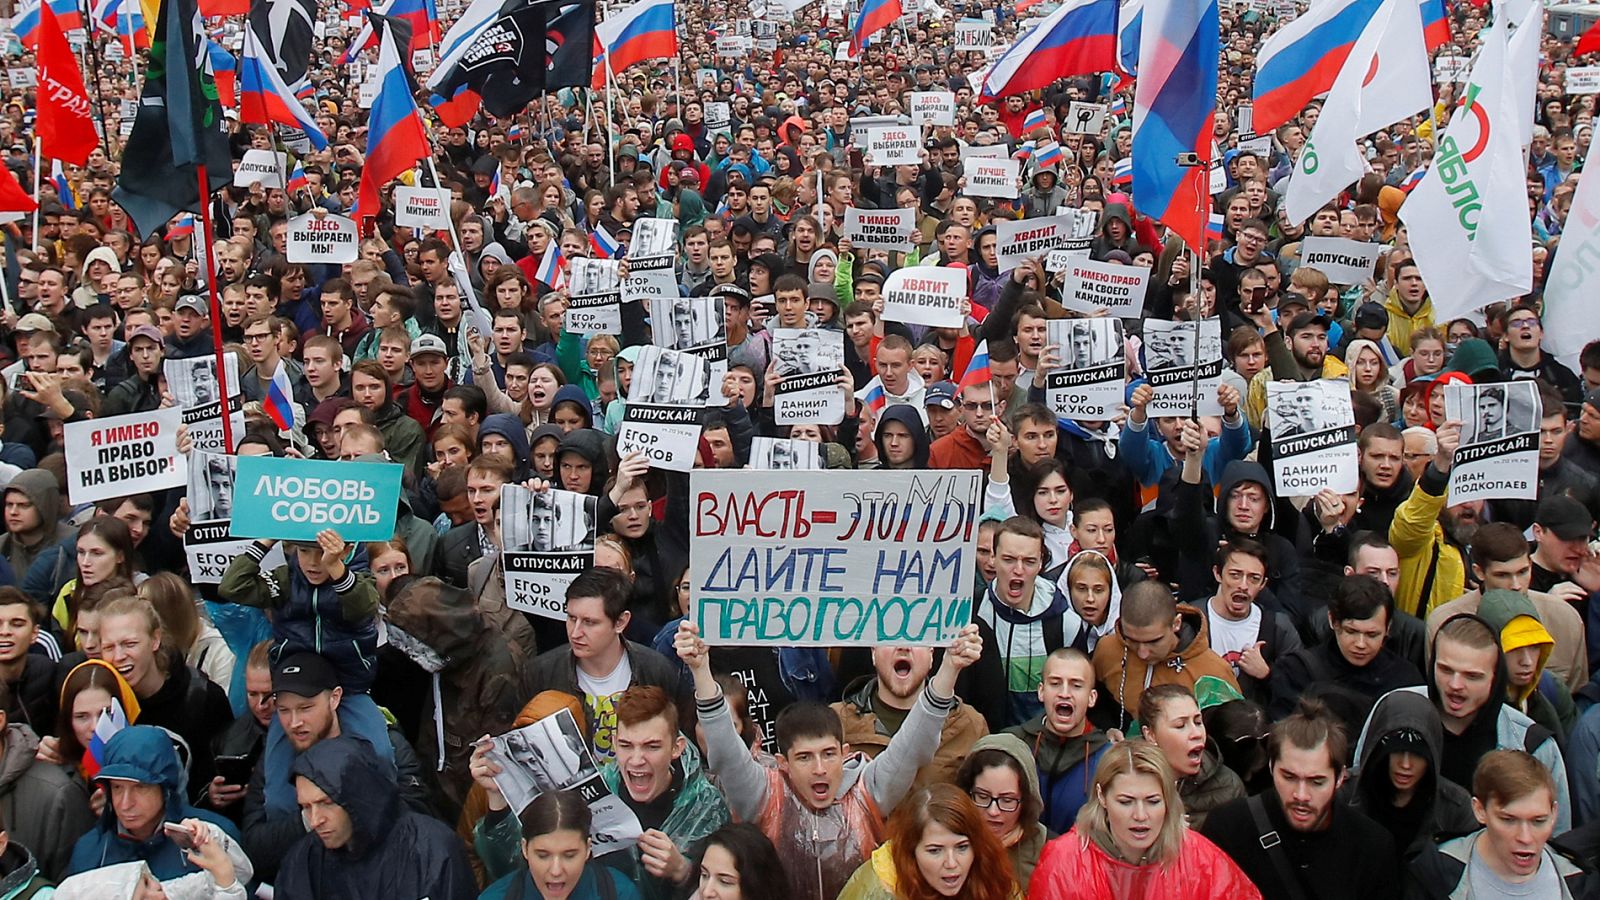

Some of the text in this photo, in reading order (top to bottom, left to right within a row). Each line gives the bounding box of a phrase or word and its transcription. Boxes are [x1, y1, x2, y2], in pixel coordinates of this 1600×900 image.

[920, 96, 941, 104] ЗДЕСЬ
[914, 104, 949, 112] ВЫБИРАЕМ
[882, 131, 907, 139] ЗДЕСЬ
[873, 141, 917, 150] ВЫБИРАЕМ
[886, 150, 904, 158] МЫ!
[977, 167, 1006, 176] ЛУЧШЕ
[972, 177, 1009, 186] МИТИНГ!
[409, 196, 438, 207] ЛУЧШЕ
[405, 205, 441, 217] МИТИНГ!
[306, 220, 340, 231] ЗДЕСЬ
[858, 215, 900, 226] Я ИМЕЮ
[861, 225, 897, 235] ПРАВО
[1014, 225, 1057, 242] ХВАТИТ
[293, 231, 352, 243] ВЫБИРАЕМ
[851, 233, 908, 245] НА ВЫБОР!
[311, 243, 334, 254] МЫ!
[1001, 234, 1067, 255] НАМ ВРАТЬ!
[628, 259, 669, 269] ТПУСКАЙ!
[1306, 252, 1370, 268] ДОПУСКАЙ!
[624, 277, 649, 288] ЕГОР
[1073, 268, 1141, 286] Я ИМЕЮ ПРАВО
[625, 286, 662, 296] ЖУКОВ
[902, 278, 949, 292] ХВАТИТ
[1081, 281, 1129, 296] НА СВОЕГО
[571, 295, 618, 307] ОТПУСКАЙ!
[888, 290, 960, 310] НАМ ВРАТЬ!
[1074, 291, 1133, 307] КАНДИДАТА!
[571, 313, 596, 322] ЕГОР
[571, 321, 608, 330] ЖУКОВ
[1055, 366, 1118, 385] ОТПУСКАЙ!
[780, 373, 839, 392] ОТПУСКАЙ!
[781, 398, 828, 410] ДАНИИЛ
[1055, 393, 1088, 404] ЕГОР
[629, 406, 697, 422] ОТПУСКАЙ!
[781, 408, 820, 419] КОНОН
[1055, 402, 1105, 415] ЖУКОВ
[91, 420, 160, 447] Я ИМЕЮ
[625, 429, 659, 444] ЕГОР
[1279, 430, 1348, 455] ОТПУСКАЙ!
[98, 440, 155, 465] ПРАВО
[1455, 438, 1530, 463] ОТПУСКАЙ!
[80, 455, 176, 487] НА ВЫБОР!
[1282, 465, 1338, 477] ДАНИИЛ
[1282, 476, 1328, 488] КОНОН
[1455, 472, 1485, 484] ИВАН
[254, 475, 375, 500] ЛЮБОВЬ
[1455, 480, 1528, 495] ПОДКОПАЕВ
[271, 501, 380, 524] СОБОЛЬ
[696, 490, 812, 538] ВЛАСТЬ
[894, 475, 979, 542] МЫ
[194, 525, 229, 540] ОТПУ
[512, 556, 585, 570] ОТПУСКАЙ!
[700, 545, 962, 594] ДАЙТЕ НАМ
[514, 578, 551, 596] ЕГОР
